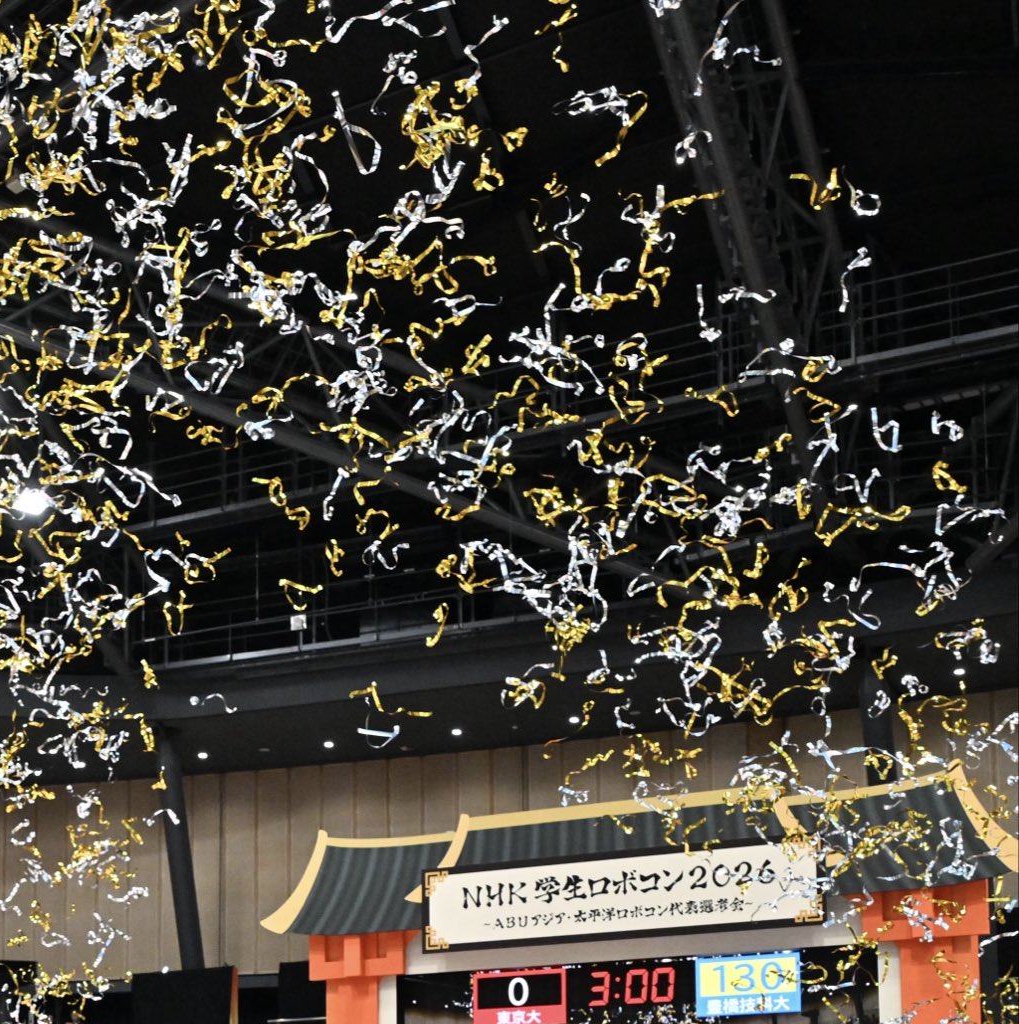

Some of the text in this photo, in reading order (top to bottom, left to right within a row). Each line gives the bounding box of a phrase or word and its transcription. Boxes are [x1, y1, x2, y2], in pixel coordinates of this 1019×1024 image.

[508, 977, 530, 1007] 0
[588, 967, 676, 1007] 3:00
[712, 962, 783, 993] 130
